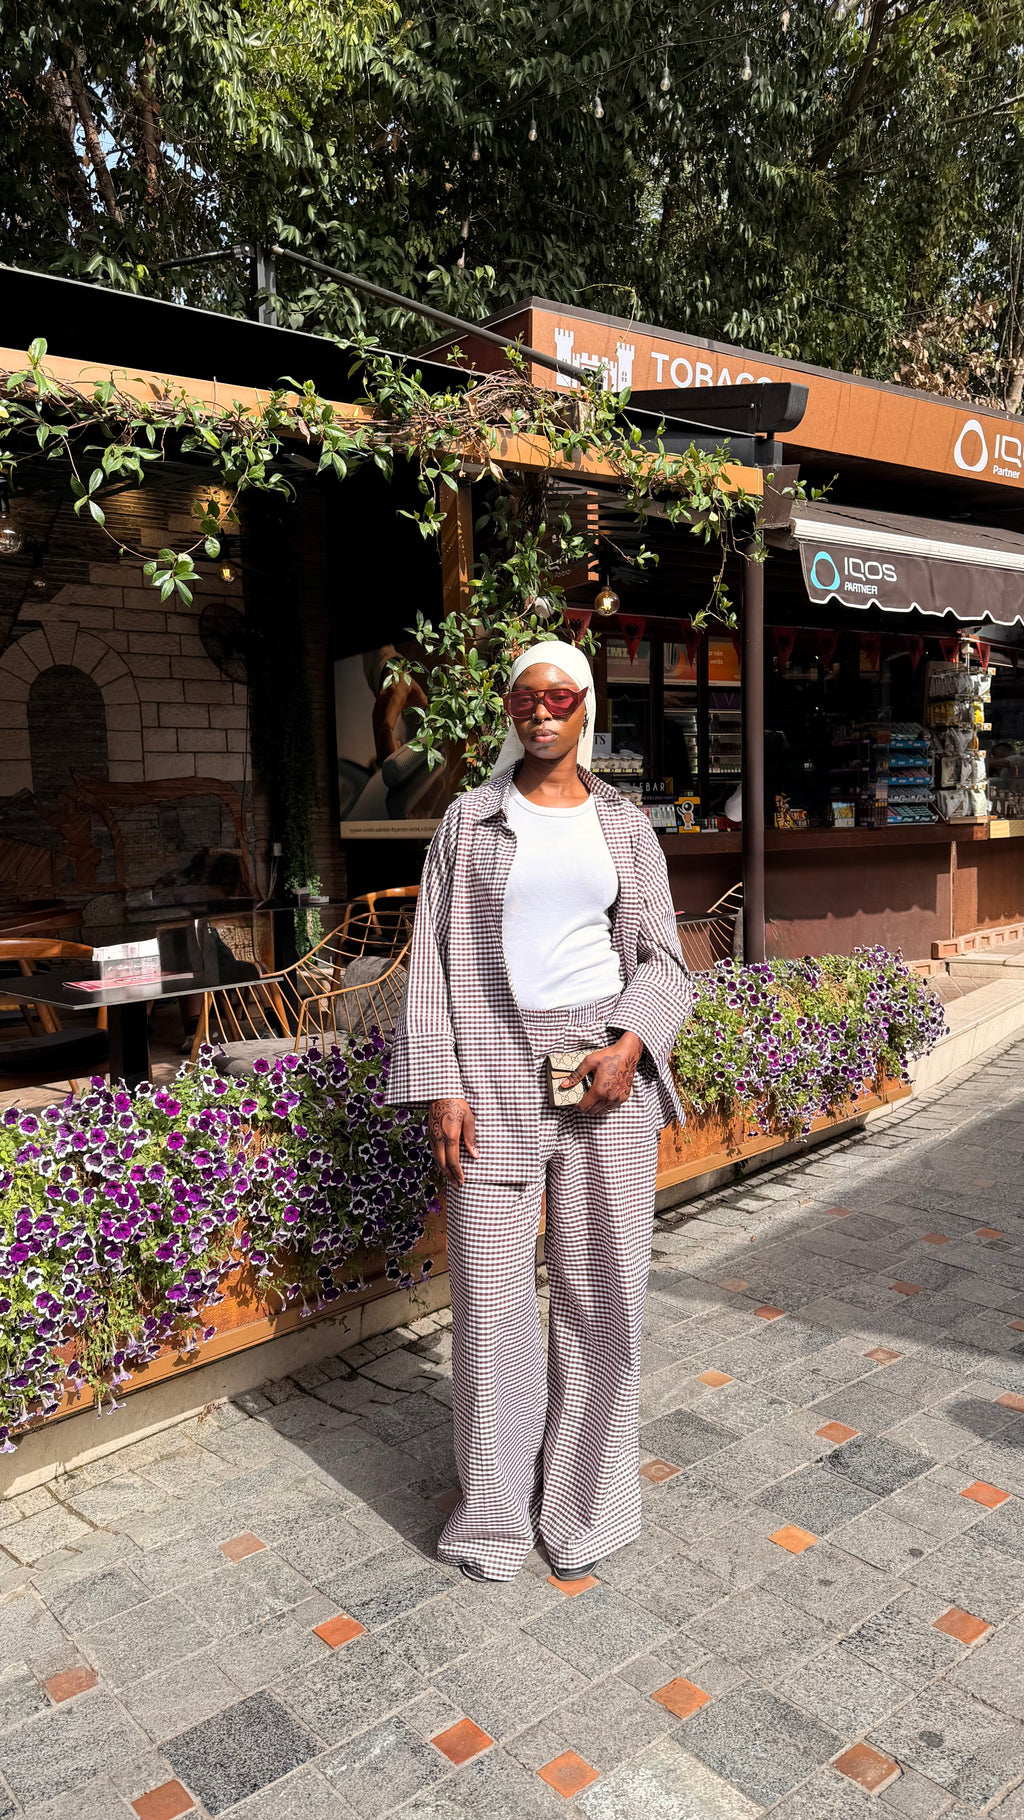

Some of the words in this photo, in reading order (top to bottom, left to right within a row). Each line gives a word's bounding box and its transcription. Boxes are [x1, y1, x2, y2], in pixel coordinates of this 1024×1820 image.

[651, 351, 773, 389] TOBA
[994, 434, 1024, 468] IQ
[993, 465, 1020, 479] Partner
[844, 557, 898, 582] IQOS
[844, 581, 878, 595] PARTNER
